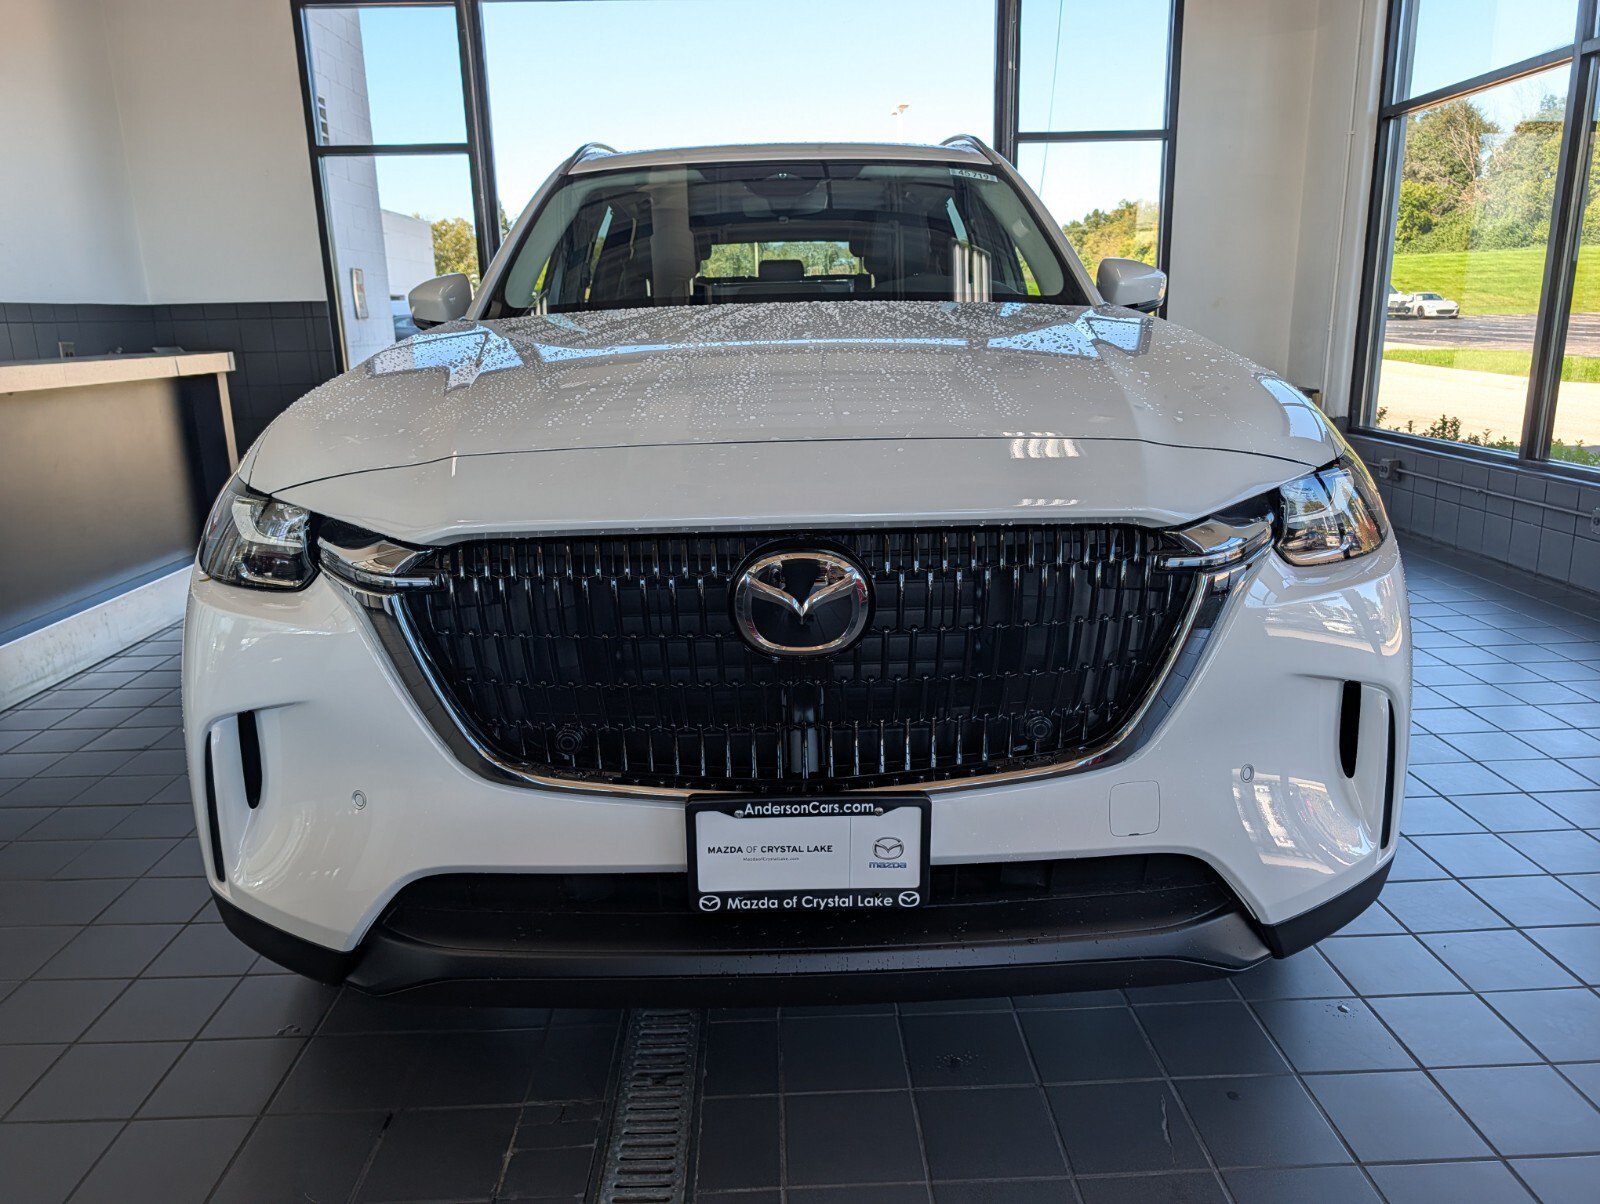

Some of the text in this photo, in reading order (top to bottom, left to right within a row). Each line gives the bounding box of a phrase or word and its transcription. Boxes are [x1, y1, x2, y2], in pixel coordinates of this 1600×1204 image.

[744, 801, 874, 816] AndersonCars.com
[707, 845, 833, 854] MAZDA OF CRYSTAL LAKE
[868, 861, 907, 869] mazda
[727, 894, 893, 910] Mazda of Crystal Lake
